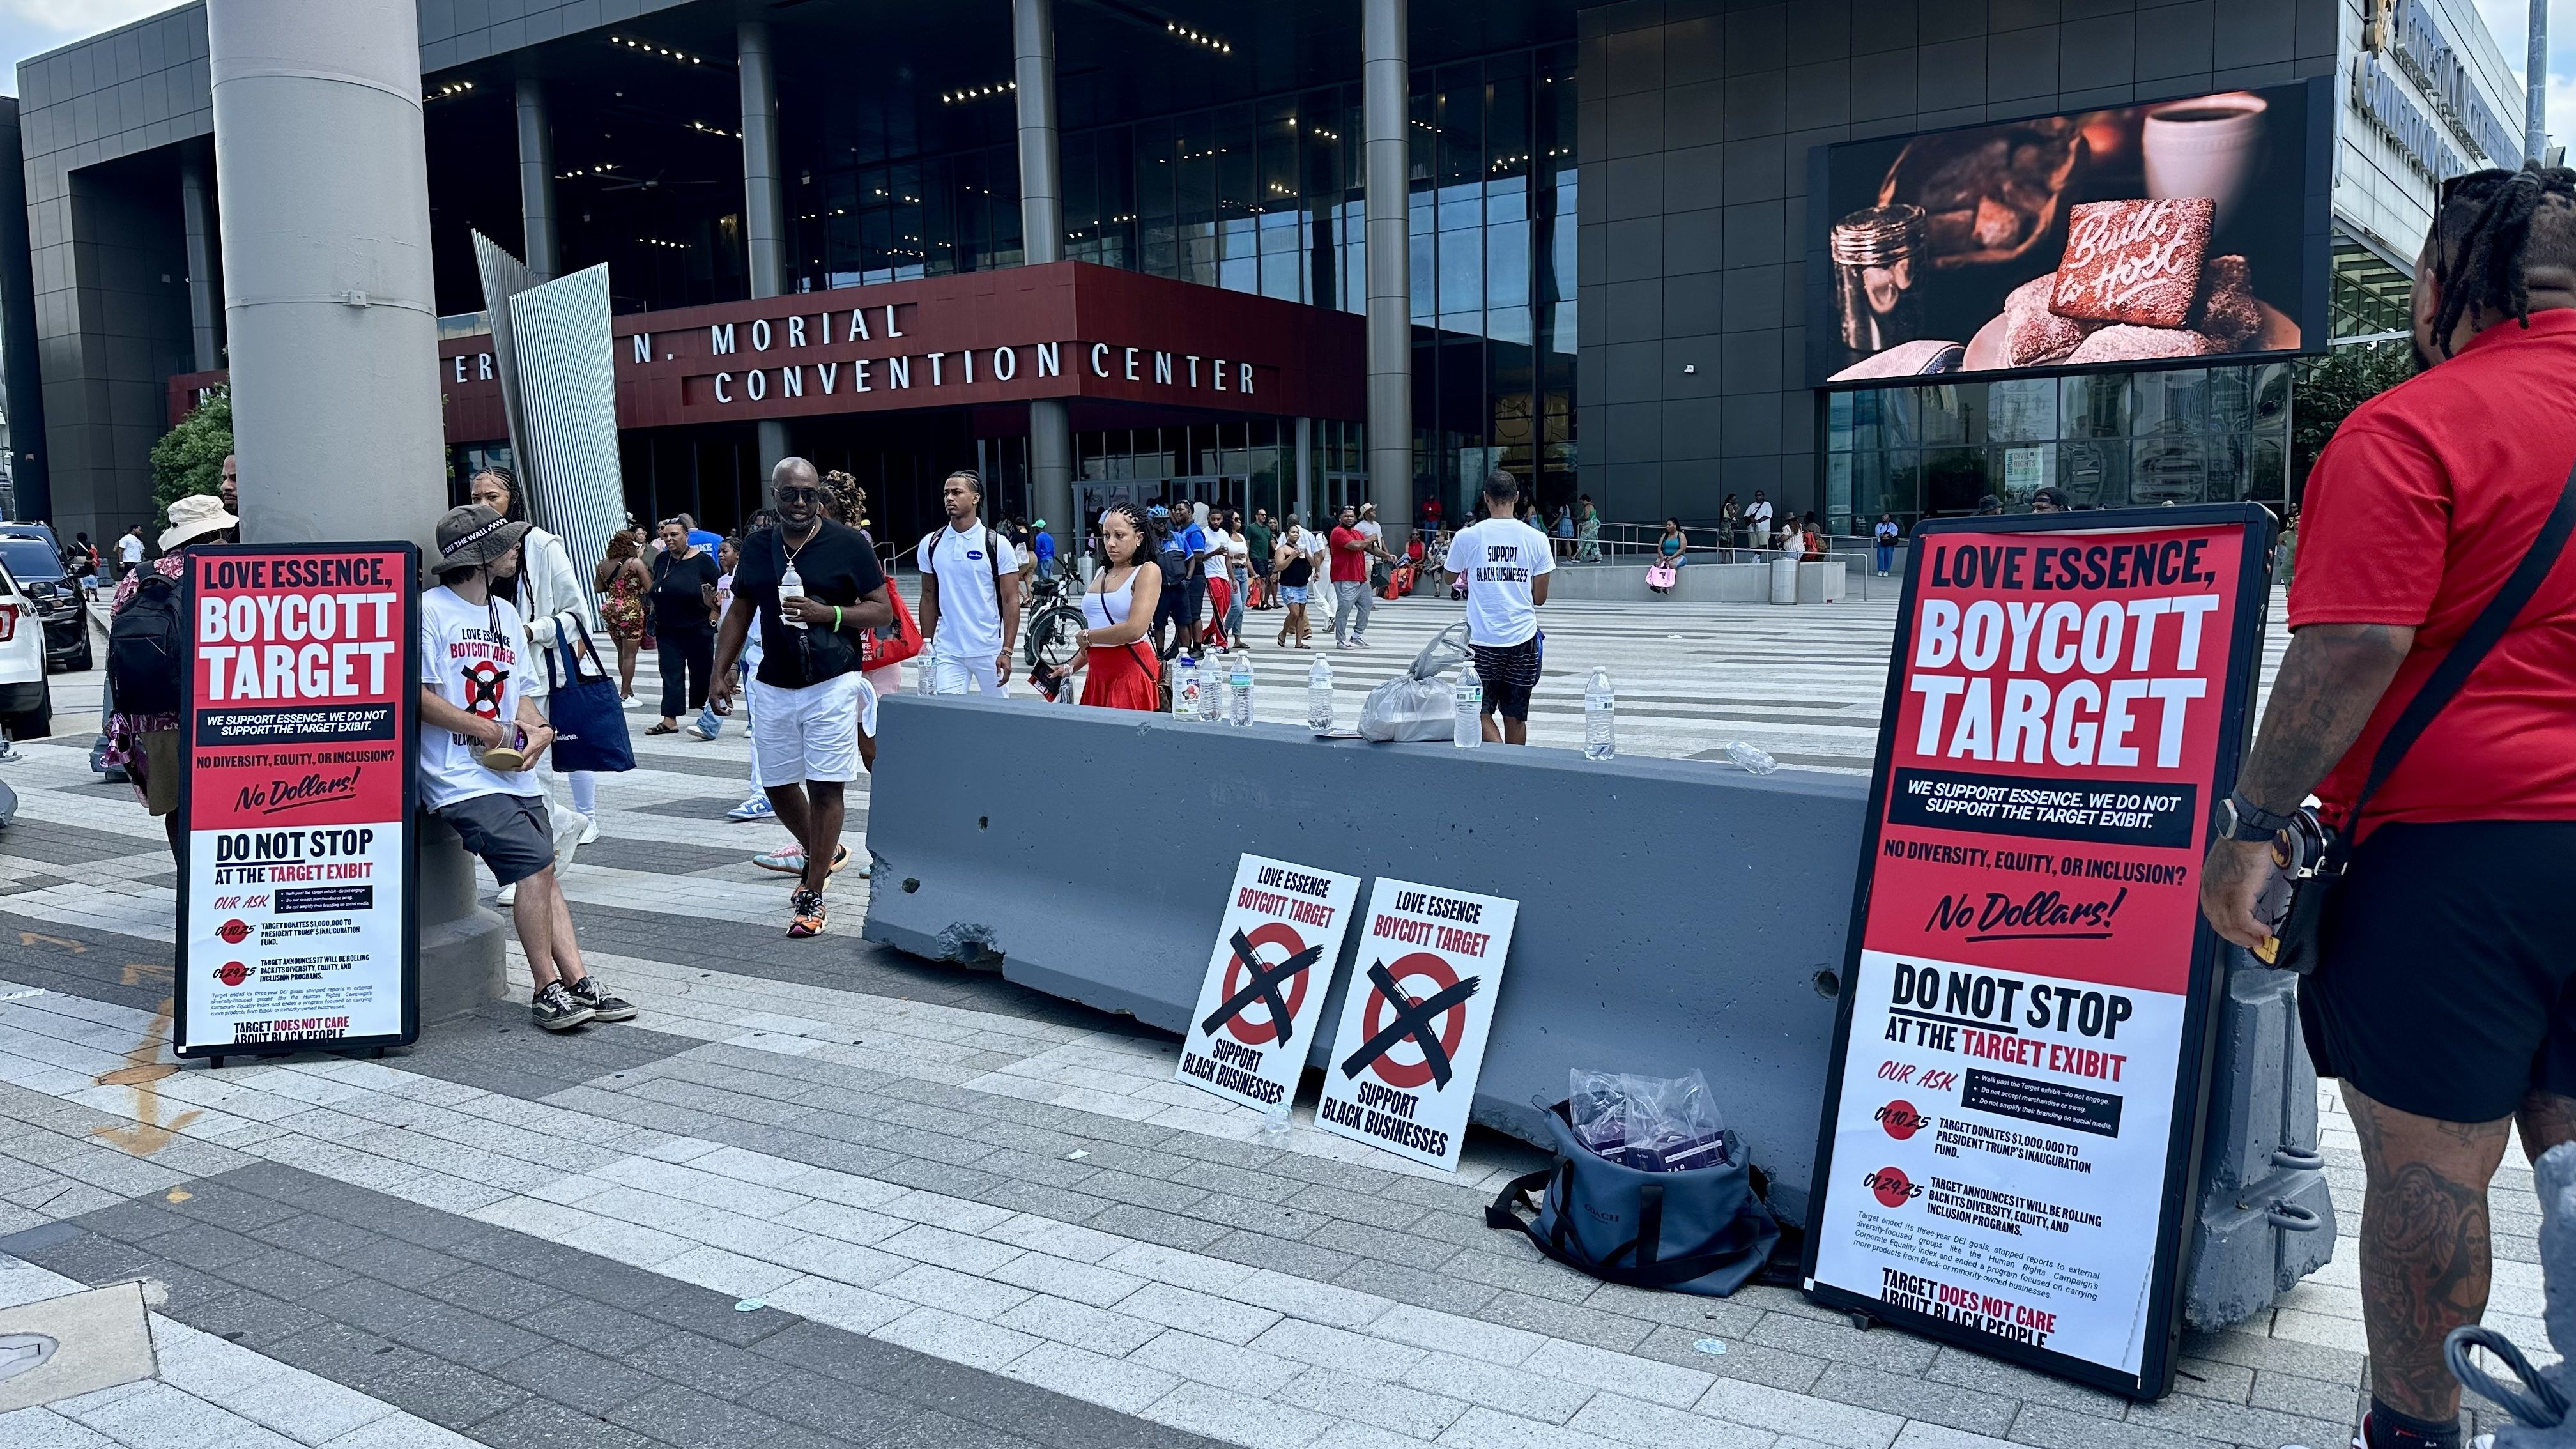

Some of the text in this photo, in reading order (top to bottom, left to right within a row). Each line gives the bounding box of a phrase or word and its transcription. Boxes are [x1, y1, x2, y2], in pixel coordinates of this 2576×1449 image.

[2067, 199, 2174, 269] Built
[2057, 225, 2190, 310] to Host
[634, 334, 674, 364] N.
[712, 305, 903, 356] MORIAL
[715, 342, 1254, 404] CONVENTION CENTER
[454, 537, 468, 548] THE
[466, 527, 488, 542] WALL
[1487, 546, 1518, 563] SUPPORT
[204, 558, 392, 590] LOVE ESSENCE,
[1476, 567, 1529, 583] BLACK BUSINESSES
[1931, 539, 2216, 590] LOVE ESSENCE,
[199, 592, 397, 643] BOYCOTT
[461, 628, 482, 641] LOVE
[1915, 594, 2220, 674] BOYCOTT
[450, 641, 489, 659] BOYCOTT
[199, 641, 395, 700] TARGET
[207, 710, 387, 726] WE SUPPORT ESSENCE. WE DO NOT
[220, 721, 371, 736] SUPPORT THE TARGET EXIBIT.
[1910, 673, 2207, 768] TARGET
[197, 749, 395, 769] NO DIVERSITY, EQUITY, OR INCLUSION?
[234, 766, 361, 813] No Dollars!
[1908, 779, 2181, 812] WE SUPPORT ESSENCE. WE DO NOT
[1925, 797, 2154, 829] SUPPORT THE TARGET EXIBIT.
[217, 829, 374, 861] DO NOT STOP
[1883, 839, 2187, 886] NO DIVERSITY, EQUITY, OR INCLUSION?
[215, 862, 374, 885] AT THE TARGET EXIBIT
[1257, 866, 1331, 898] LOVE ESSENCE
[214, 896, 241, 910] OUR
[242, 894, 270, 908] ASK
[1236, 887, 1335, 929] BOYCOTT TARGET
[1395, 890, 1483, 924] LOVE ESSENCE
[1924, 887, 2128, 932] No Dollars!
[1372, 914, 1491, 958] BOYCOTT TARGET
[1892, 963, 2133, 1040] DO NOT STOP
[1212, 1038, 1264, 1073] SUPPORT
[1884, 1016, 2127, 1082] AT THE TARGET EXIBIT
[1181, 1052, 1285, 1105] BLACK BUSINESSES
[1878, 1060, 1959, 1092] OUR ASK
[1357, 1080, 1419, 1119] SUPPORT
[1874, 1106, 1931, 1131] 01.10.25
[1321, 1096, 1448, 1157] BLACK BUSINESSES
[1939, 1117, 2078, 1157] TARGET DONATES $1,000,000 TO
[1935, 1143, 1959, 1158] FUND.
[1936, 1130, 2092, 1174] PRESIDENT TRUMP'S INAUGURATION
[1863, 1172, 1925, 1199] 01.24.25
[1931, 1176, 2102, 1227] TARGET ANNOUNCES IT WILL BE ROLLING
[1584, 1203, 1620, 1222] COACH
[1927, 1202, 2023, 1236] INCLUSION PROGRAMS.
[1929, 1189, 2069, 1233] BACK ITS DIVERSITY, EQUITY, AND
[1856, 1220, 2099, 1290] diversity-focused groups like the Human Rights Campaign's
[1858, 1210, 1880, 1222] Target
[1882, 1218, 1903, 1229] ended
[1917, 1227, 1952, 1241] three-year
[1953, 1235, 1966, 1245] DEI
[1968, 1241, 1990, 1253] goals,
[1994, 1247, 2024, 1260] stopped
[2027, 1255, 2053, 1268] reports
[2057, 1262, 2065, 1271] to
[2068, 1267, 2101, 1280] external
[1882, 1267, 2057, 1334] TARGET DOES NOT CARE
